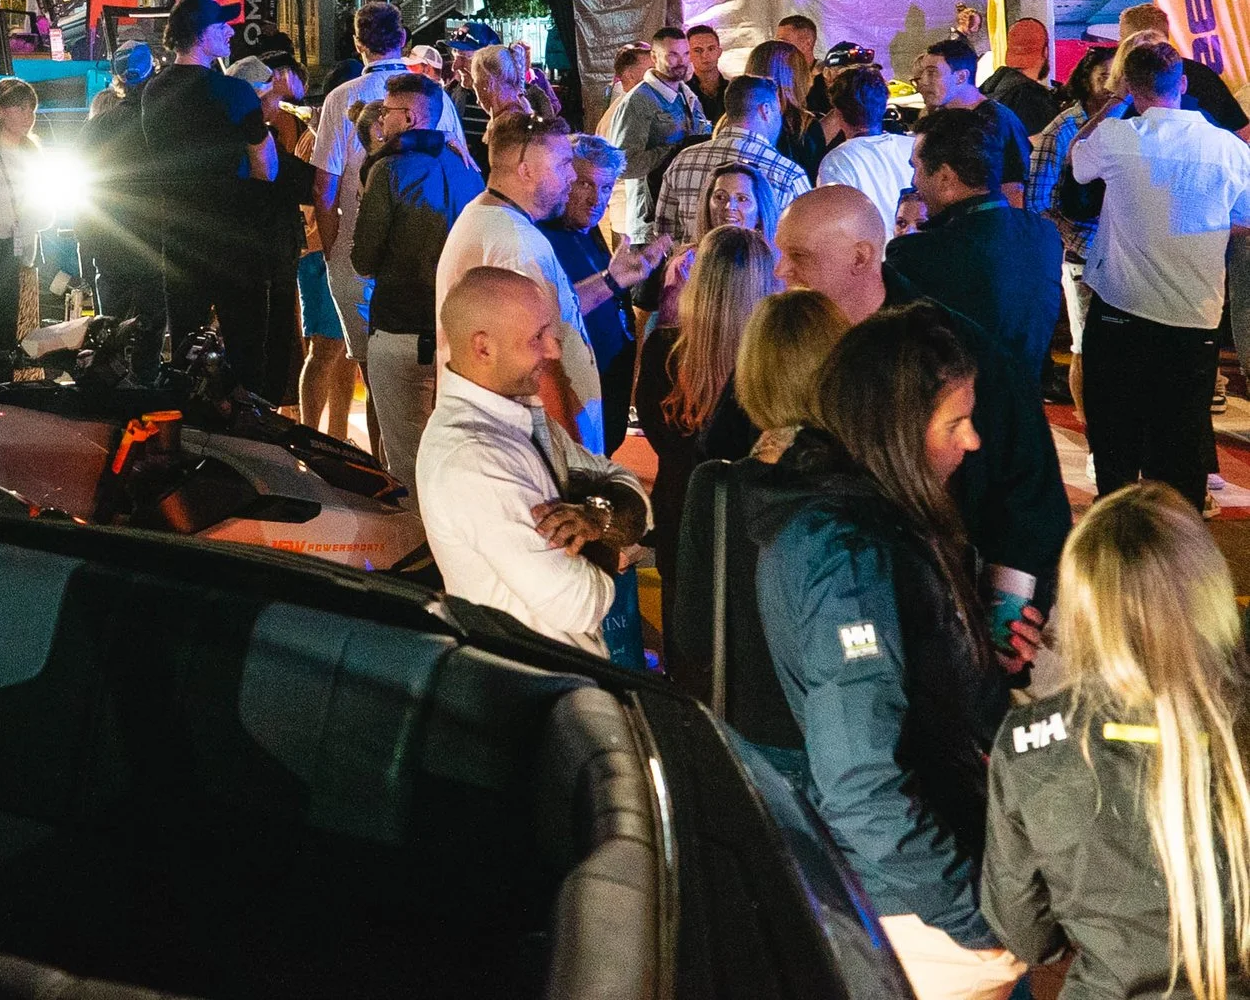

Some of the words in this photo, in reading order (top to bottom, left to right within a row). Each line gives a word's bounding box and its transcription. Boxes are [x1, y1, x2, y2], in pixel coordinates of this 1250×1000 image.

[307, 543, 386, 552] POWERSPORTS
[840, 623, 877, 649] HH
[1012, 711, 1068, 754] HH
